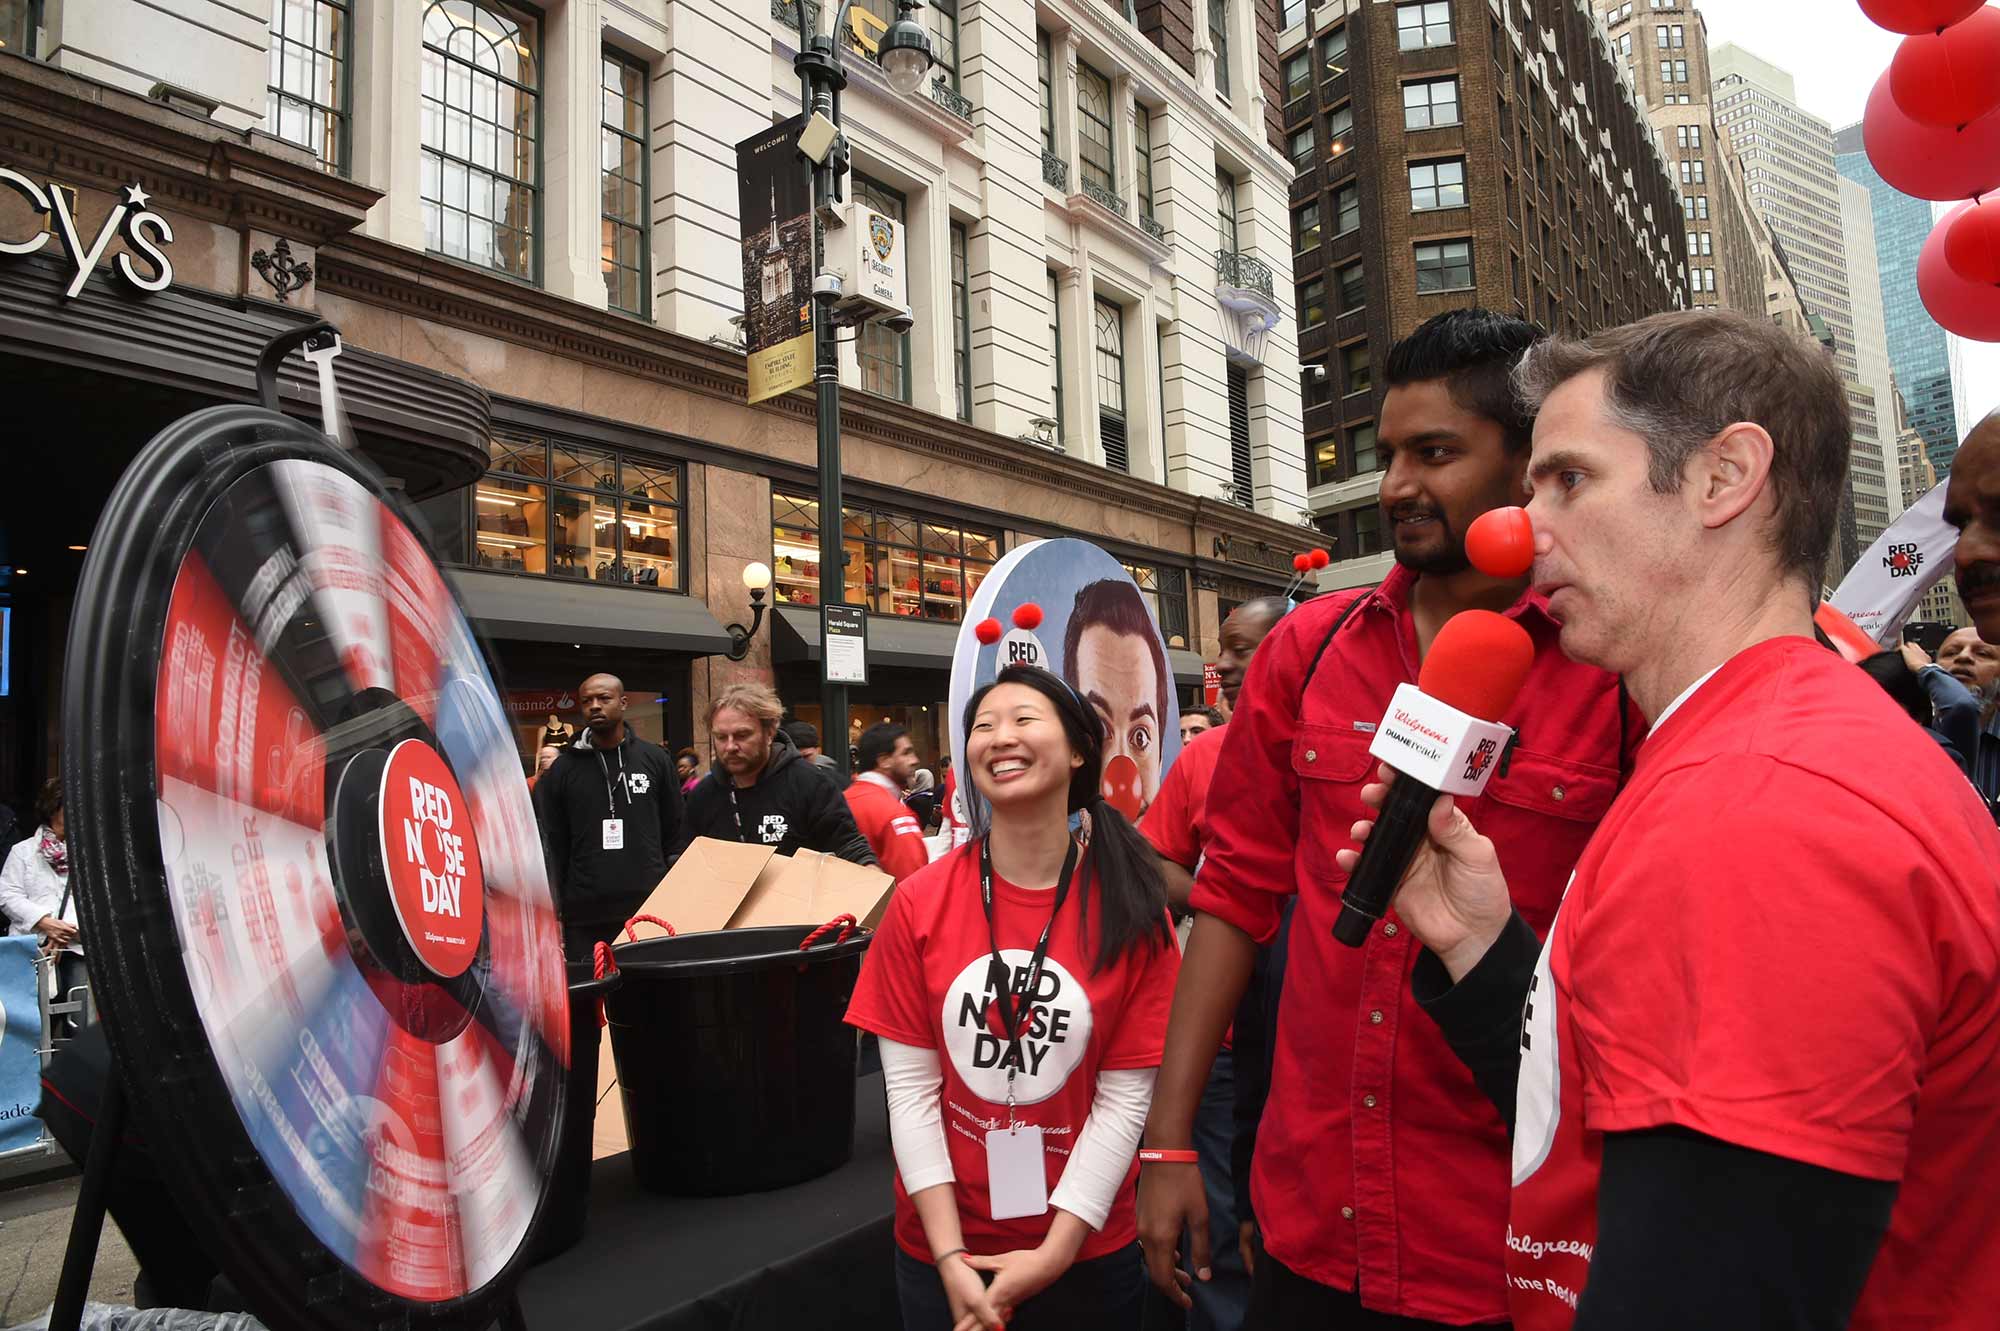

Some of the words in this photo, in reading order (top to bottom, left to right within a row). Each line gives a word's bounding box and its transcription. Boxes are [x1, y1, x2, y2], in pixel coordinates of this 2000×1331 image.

[754, 133, 788, 154] WELCOME!
[1888, 543, 1917, 556] RED
[1890, 565, 1918, 578] DAY
[1009, 641, 1038, 663] RED
[215, 617, 247, 767] COMPACT
[235, 649, 264, 769] MIRROR
[1394, 708, 1448, 744] Walgreens
[1477, 738, 1496, 754] RED
[1463, 767, 1484, 780] DAY
[409, 776, 452, 829] RED
[763, 815, 784, 825] RED
[763, 832, 784, 842] DAY
[231, 842, 264, 944] HEAD
[419, 868, 460, 917] DAY
[984, 960, 1061, 1002] RED
[972, 1033, 1050, 1076] DAY
[1046, 1145, 1069, 1155] Nose
[1514, 1277, 1544, 1291] the
